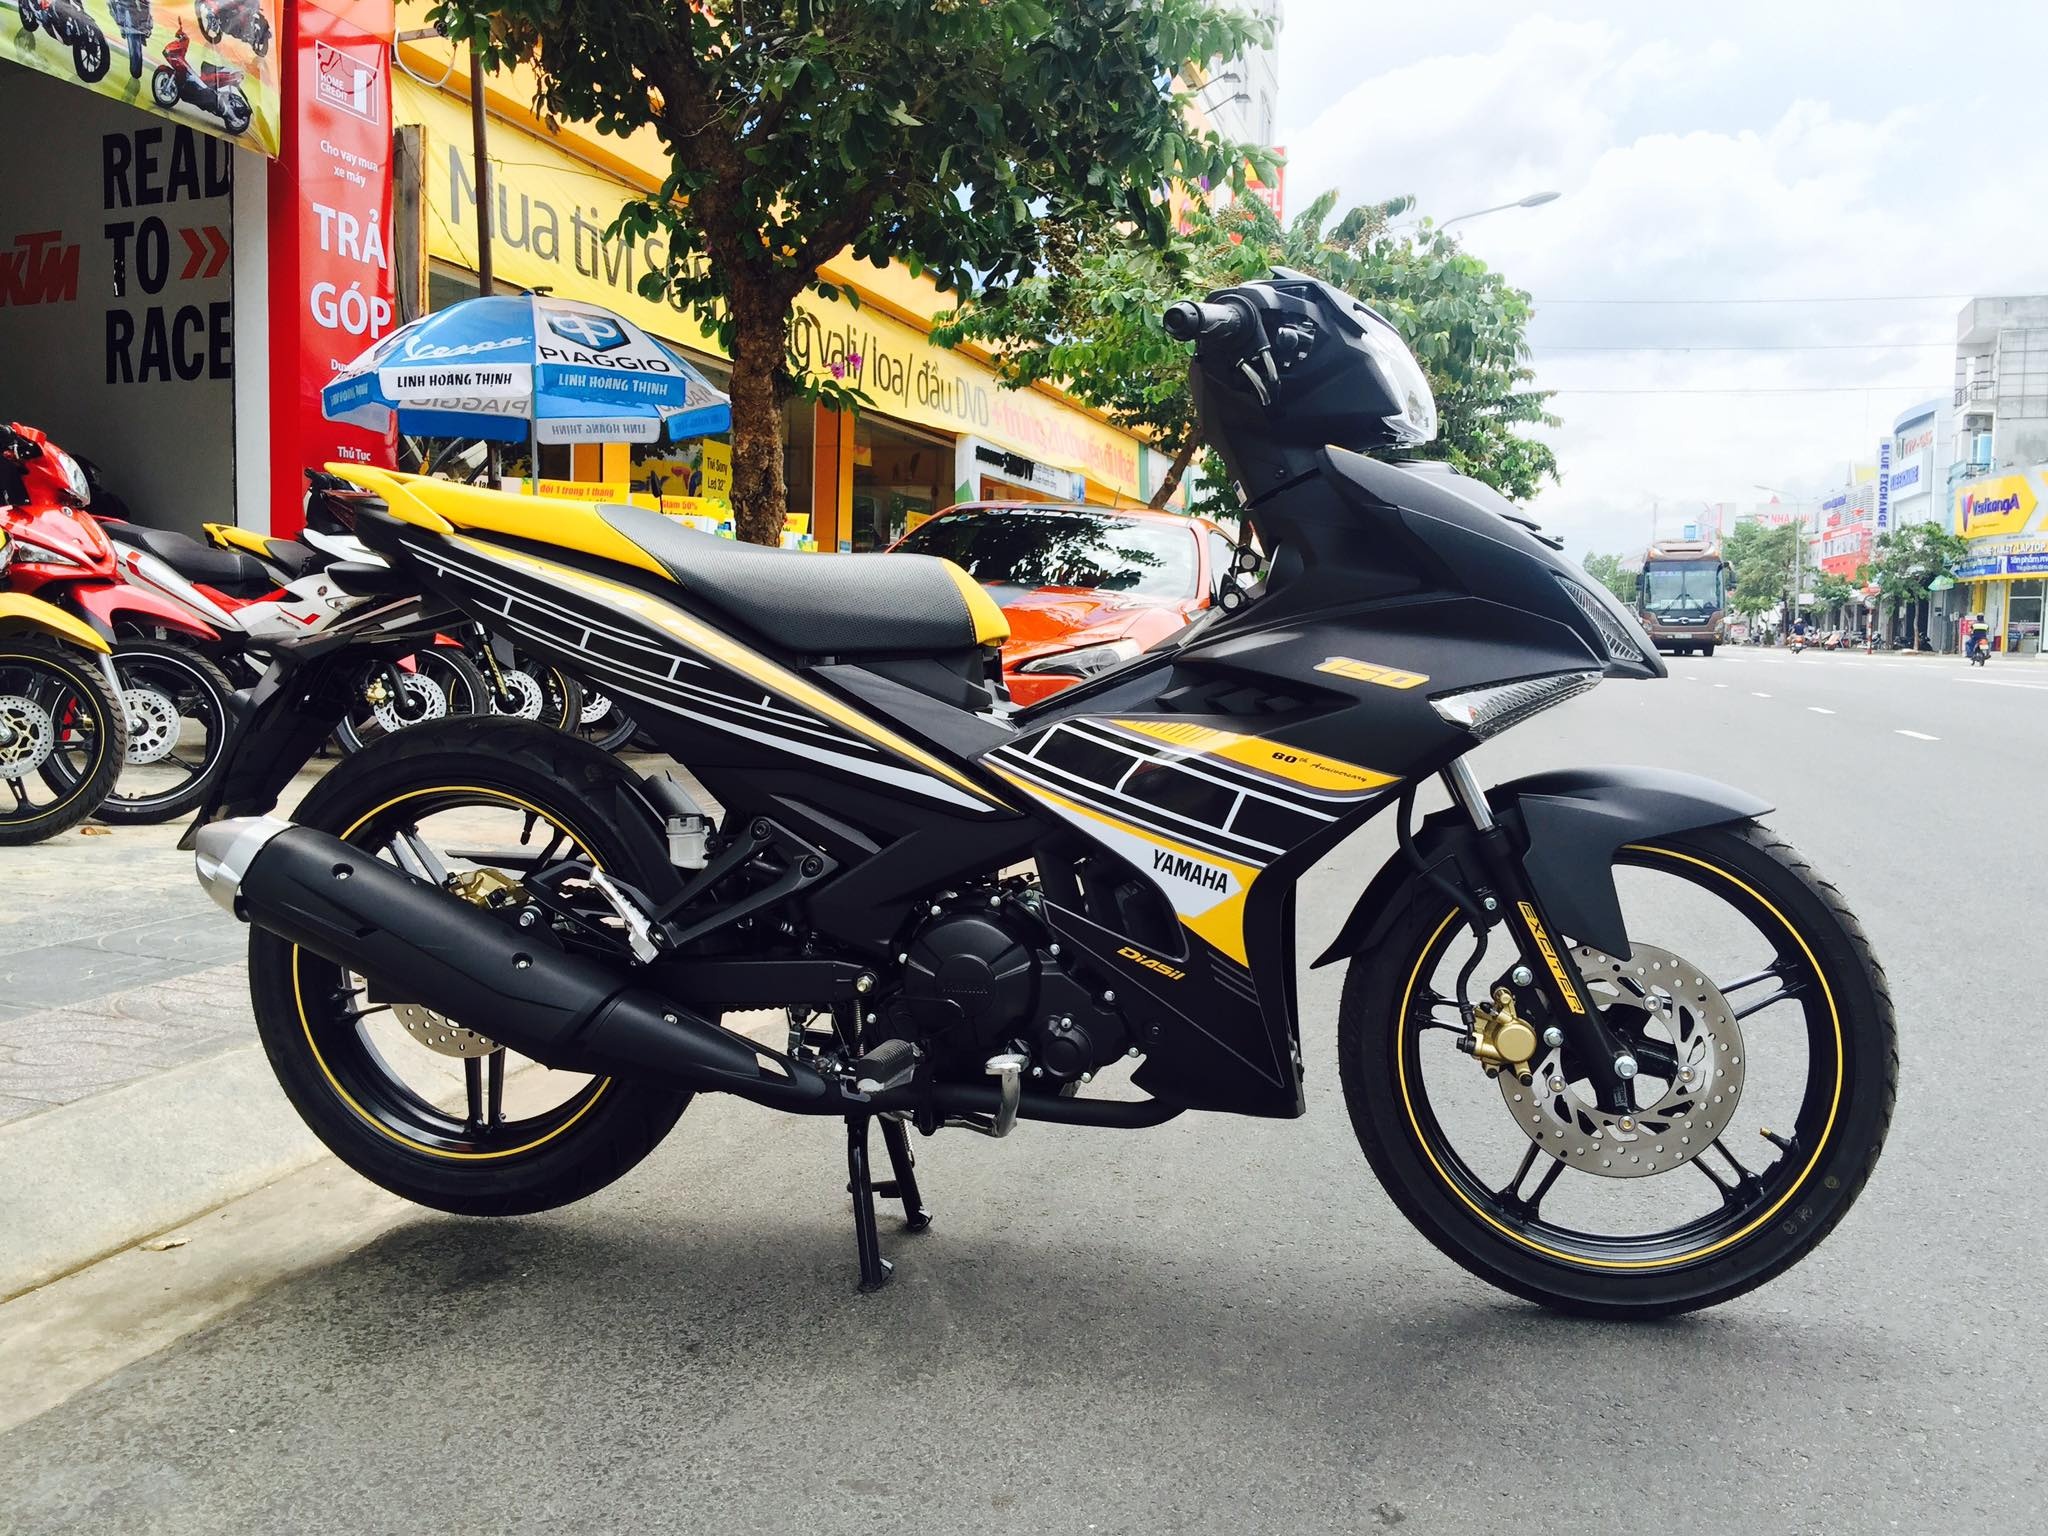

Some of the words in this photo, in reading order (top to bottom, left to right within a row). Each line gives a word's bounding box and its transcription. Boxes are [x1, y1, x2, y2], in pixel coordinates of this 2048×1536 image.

[320, 74, 344, 90] HOME
[320, 82, 348, 101] CREDIT
[320, 140, 339, 157] Cho
[340, 150, 358, 167] vay
[358, 157, 379, 173] mua
[334, 165, 345, 178] xe
[346, 169, 366, 188] máy
[449, 144, 560, 264] Mua
[312, 202, 388, 270] TRẢ
[0, 230, 81, 308] KTM
[104, 216, 170, 297] TO
[310, 280, 392, 340] GÓP
[106, 301, 232, 384] RACE
[400, 334, 533, 362] Vespa
[538, 344, 670, 373] PIAGGIO
[397, 375, 425, 388] LINH
[429, 371, 472, 386] HOÀNG
[475, 373, 513, 387] THỊNH
[558, 373, 587, 387] LINH
[917, 360, 952, 416] đầu
[956, 377, 989, 427] DVD
[337, 446, 355, 458] Thủ
[1880, 443, 1890, 470] BLUE
[1877, 473, 1889, 528] EXCHANGE
[1314, 657, 1430, 690] 150
[1310, 763, 1368, 783] Anniversary
[1153, 849, 1228, 894] YAMAHA
[1517, 901, 1585, 1015] EXCITER
